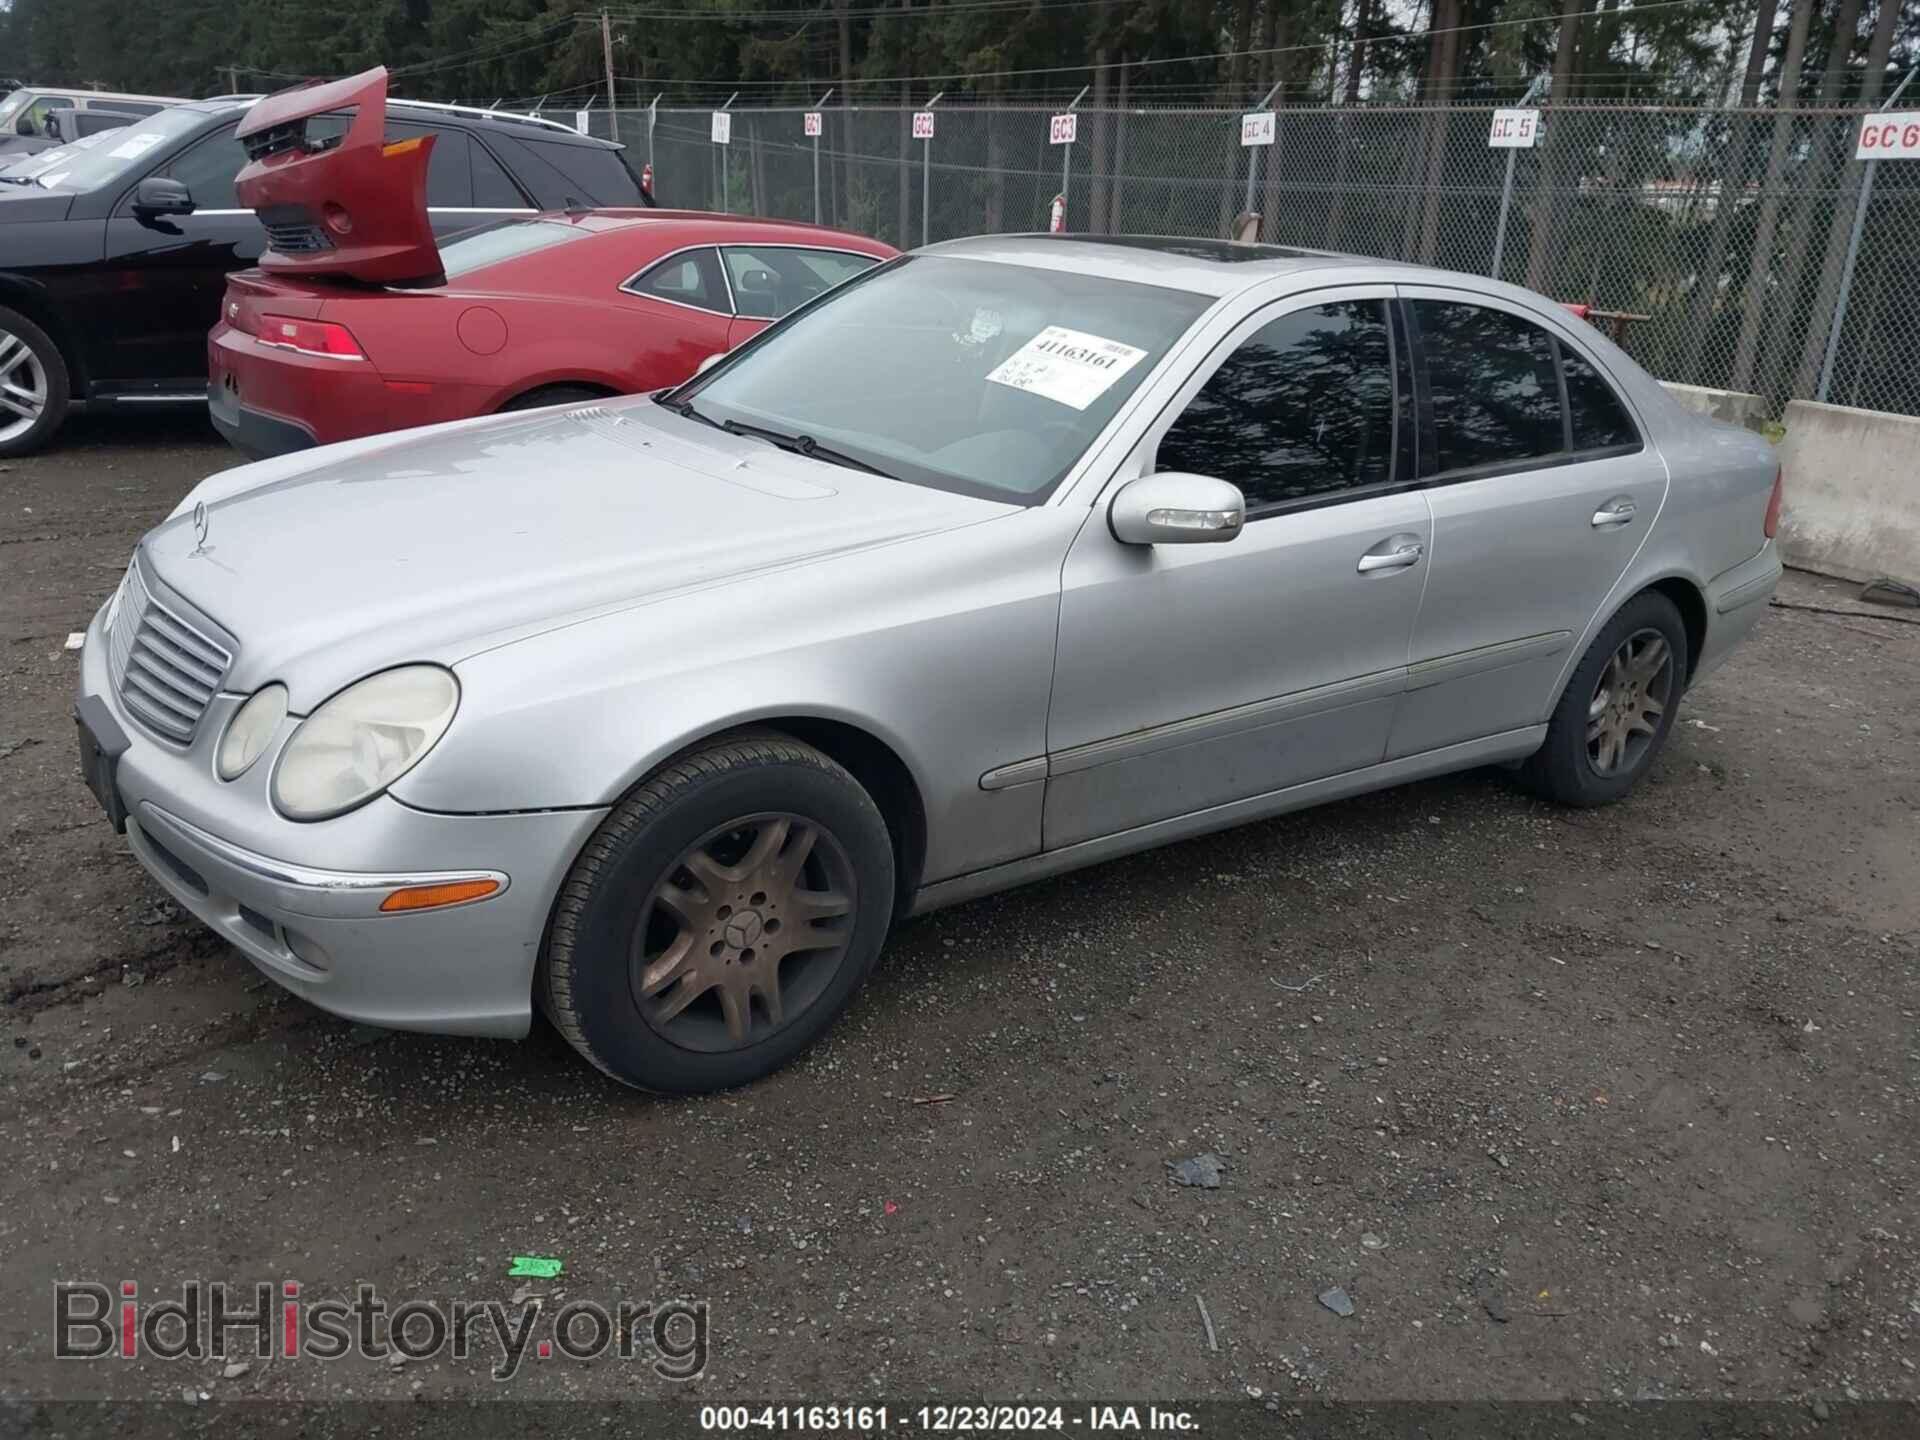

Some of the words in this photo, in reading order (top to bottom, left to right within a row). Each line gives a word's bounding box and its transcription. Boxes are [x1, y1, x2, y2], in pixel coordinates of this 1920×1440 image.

[914, 115, 933, 136] GC2
[1052, 117, 1074, 141] GC3
[1037, 339, 1118, 370] 41163161
